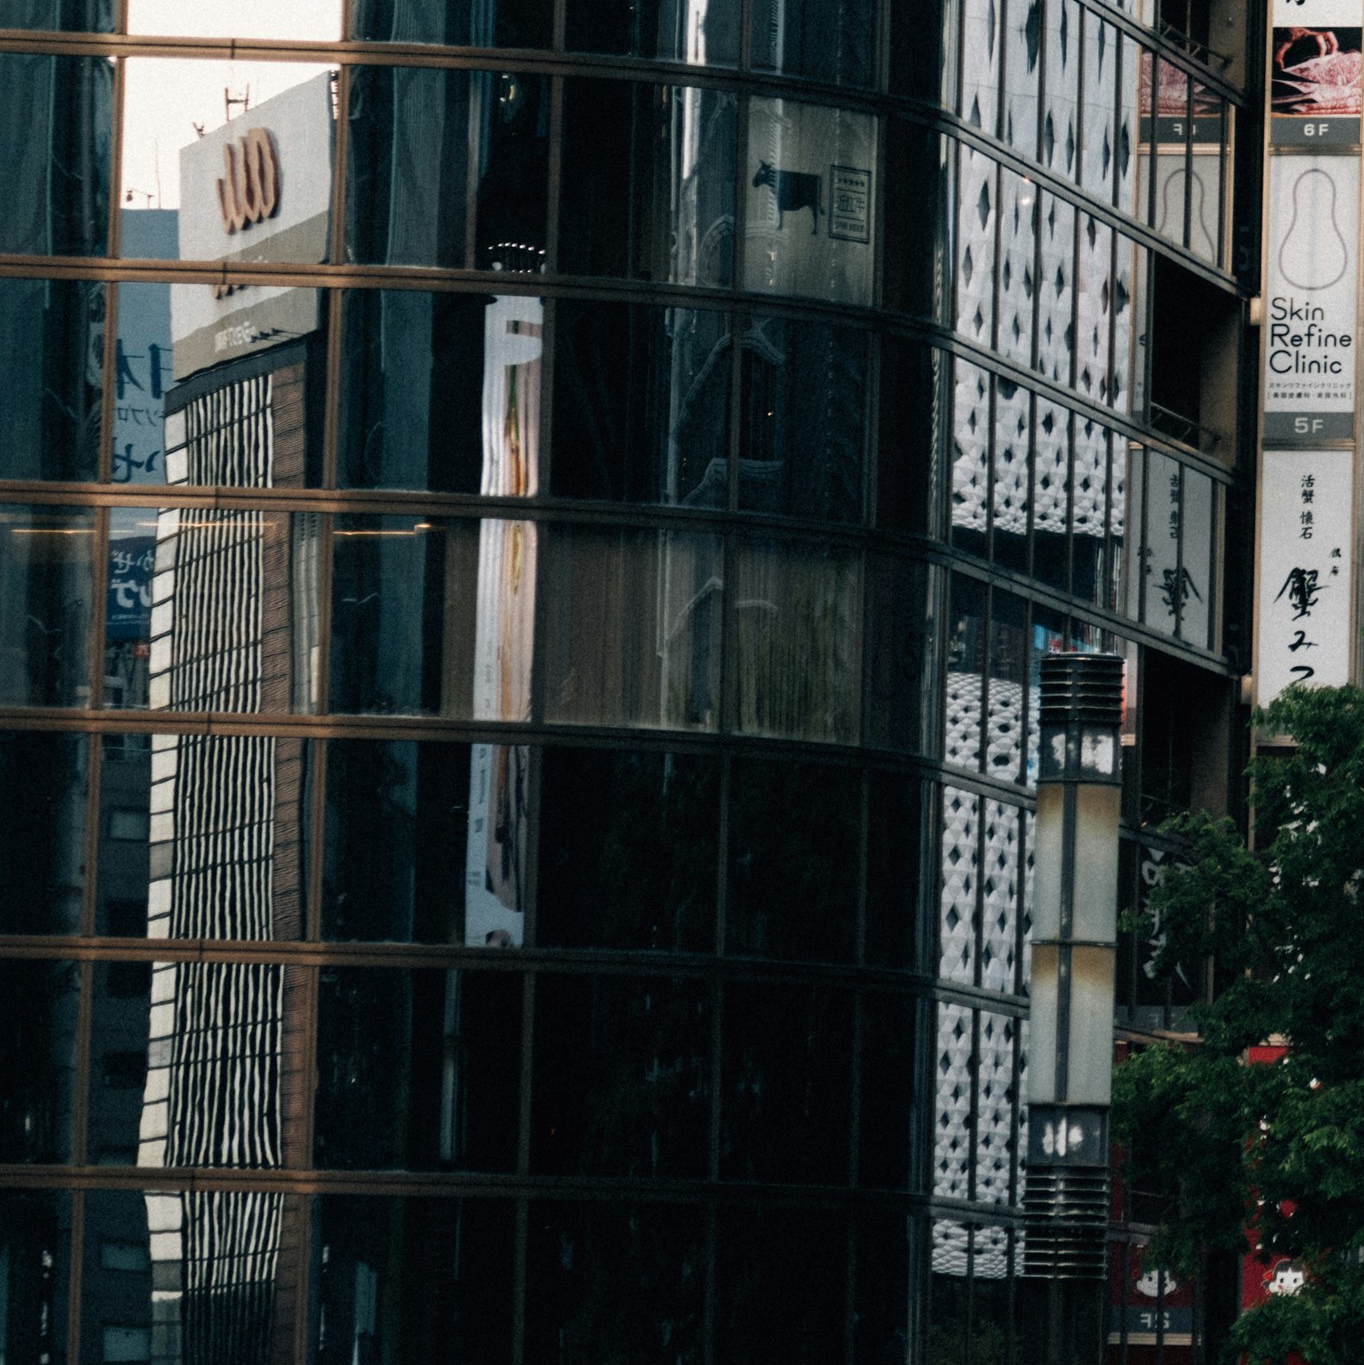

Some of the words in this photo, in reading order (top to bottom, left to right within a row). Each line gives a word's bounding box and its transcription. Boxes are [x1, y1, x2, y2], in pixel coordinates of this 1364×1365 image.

[1304, 124, 1329, 136] 6F
[1271, 297, 1324, 321] Skin
[1271, 323, 1352, 347] Refine
[1269, 350, 1342, 374] Clinic
[1295, 418, 1324, 434] 5F
